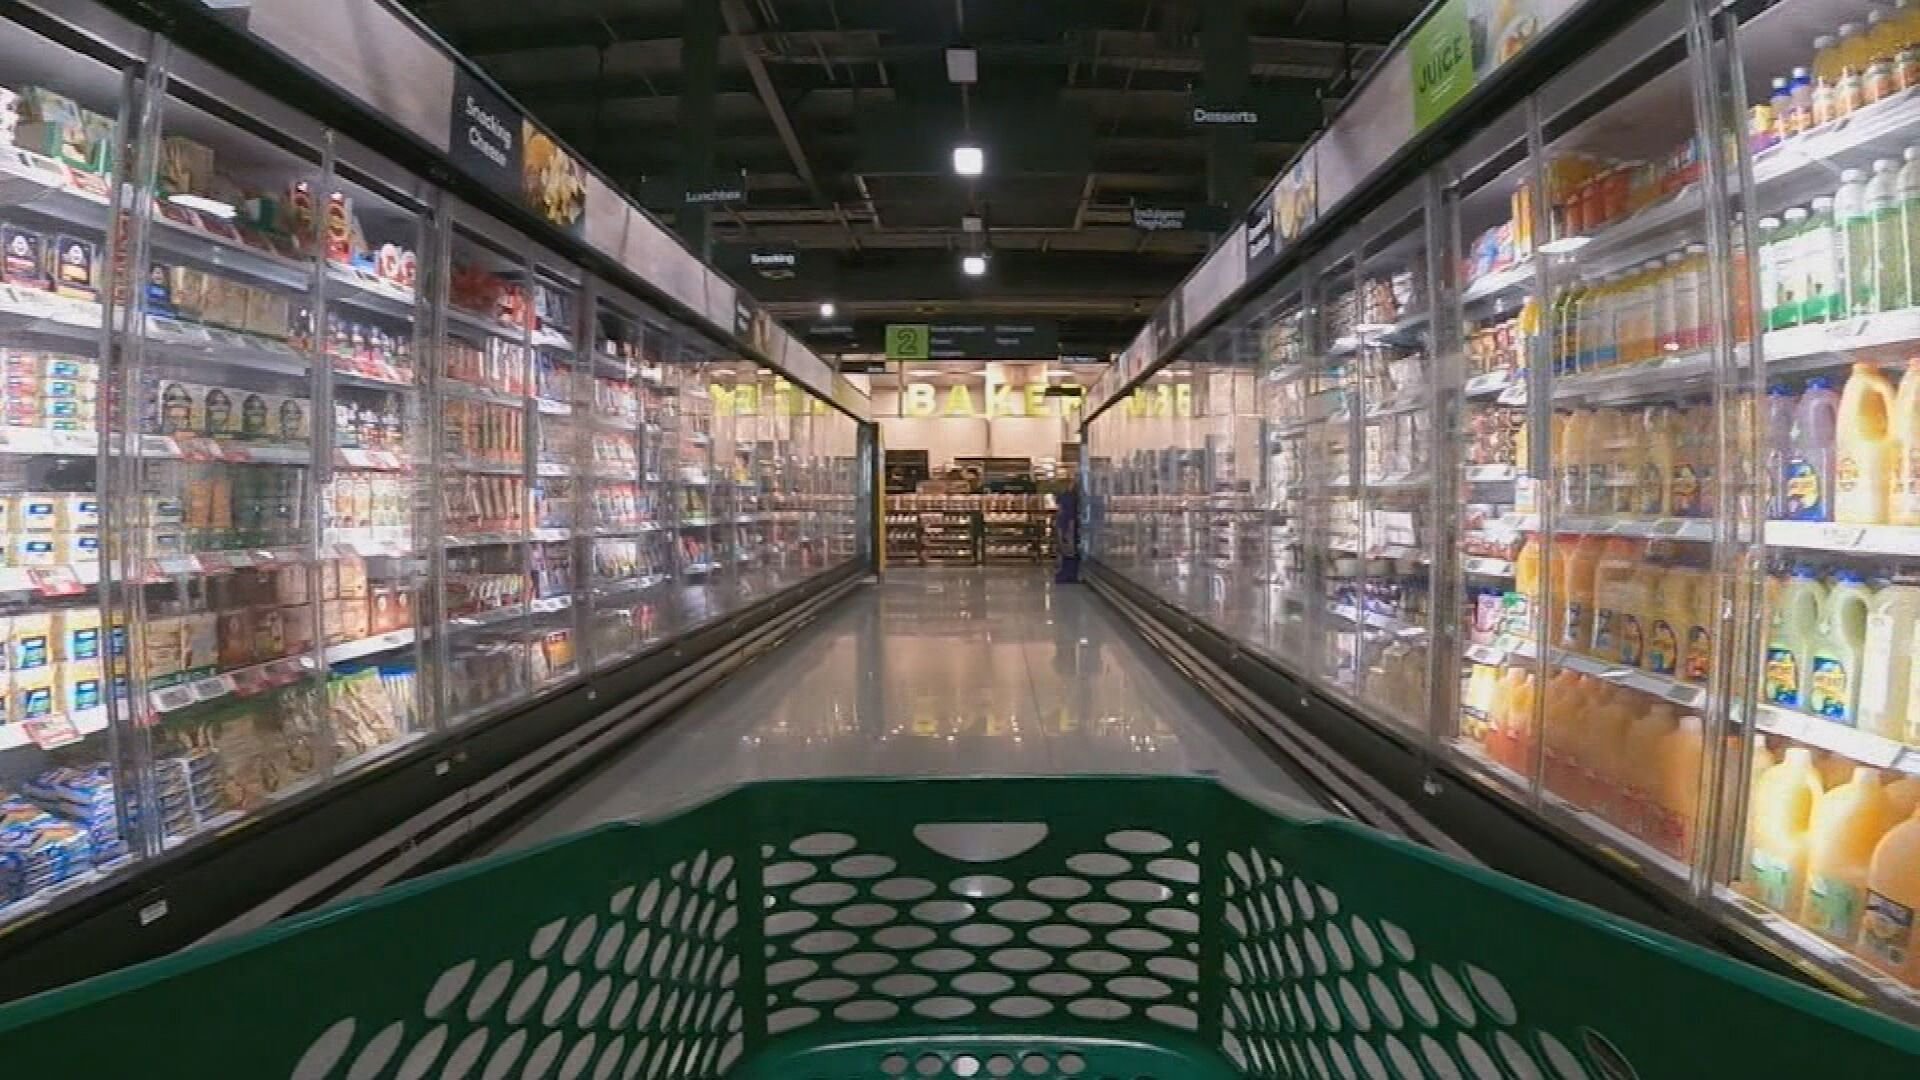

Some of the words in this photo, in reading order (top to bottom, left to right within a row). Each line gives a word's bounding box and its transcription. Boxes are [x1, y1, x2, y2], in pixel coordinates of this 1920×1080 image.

[1419, 36, 1464, 93] JUICE
[465, 95, 512, 150] Snacking
[1193, 109, 1258, 123] Desserts
[685, 190, 741, 203] Lunchbox
[896, 327, 919, 356] 2
